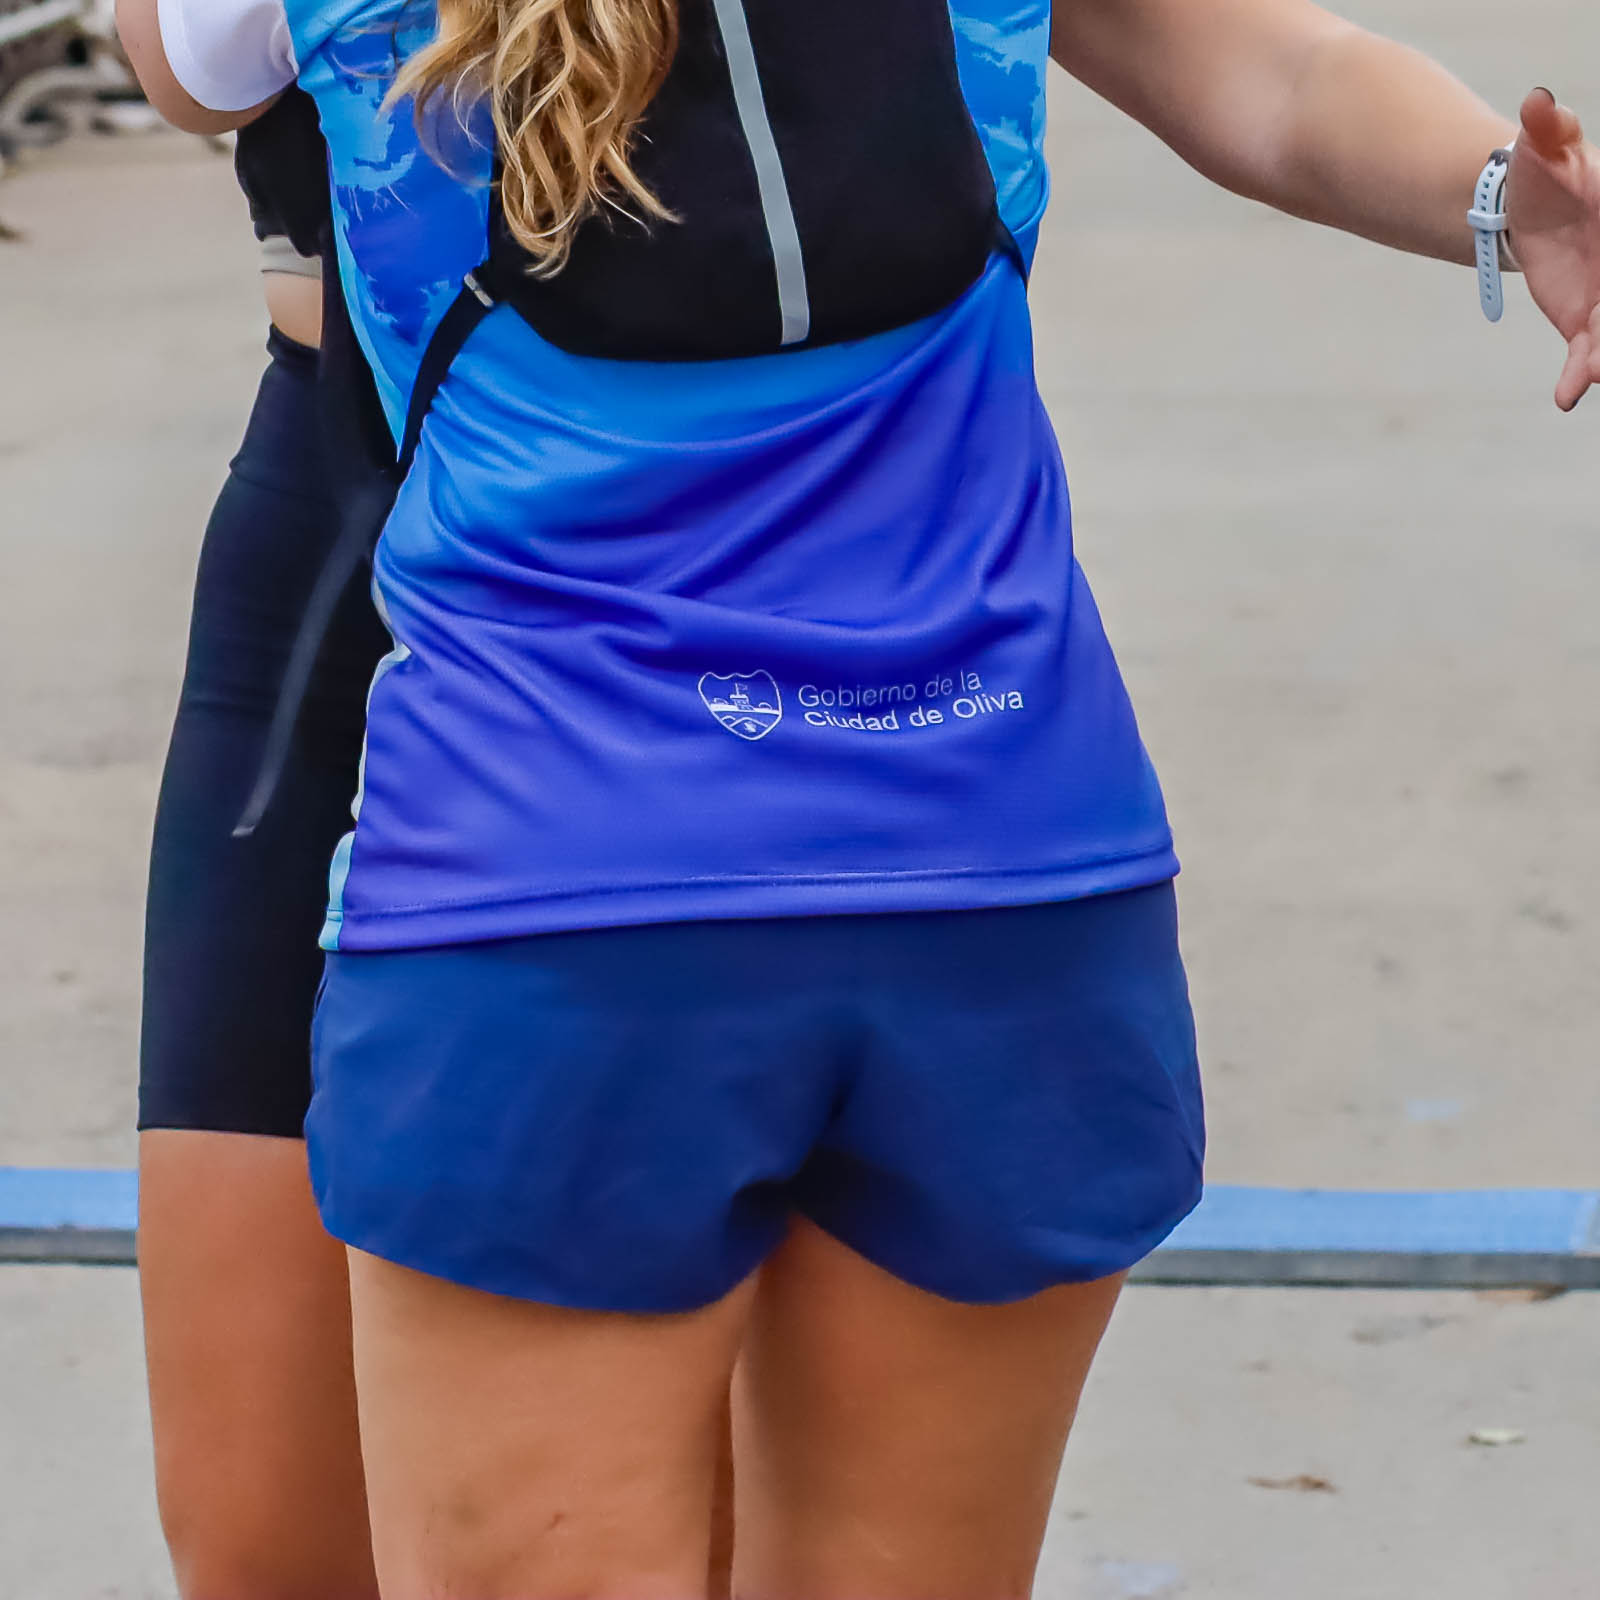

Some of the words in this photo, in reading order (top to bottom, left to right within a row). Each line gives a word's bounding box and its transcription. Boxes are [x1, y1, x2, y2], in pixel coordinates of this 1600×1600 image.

[798, 684, 916, 707] Gobierno
[925, 675, 952, 698] de
[960, 670, 982, 693] la
[804, 710, 899, 730] Ciudad
[909, 706, 943, 727] de
[952, 690, 1023, 718] Oliva
